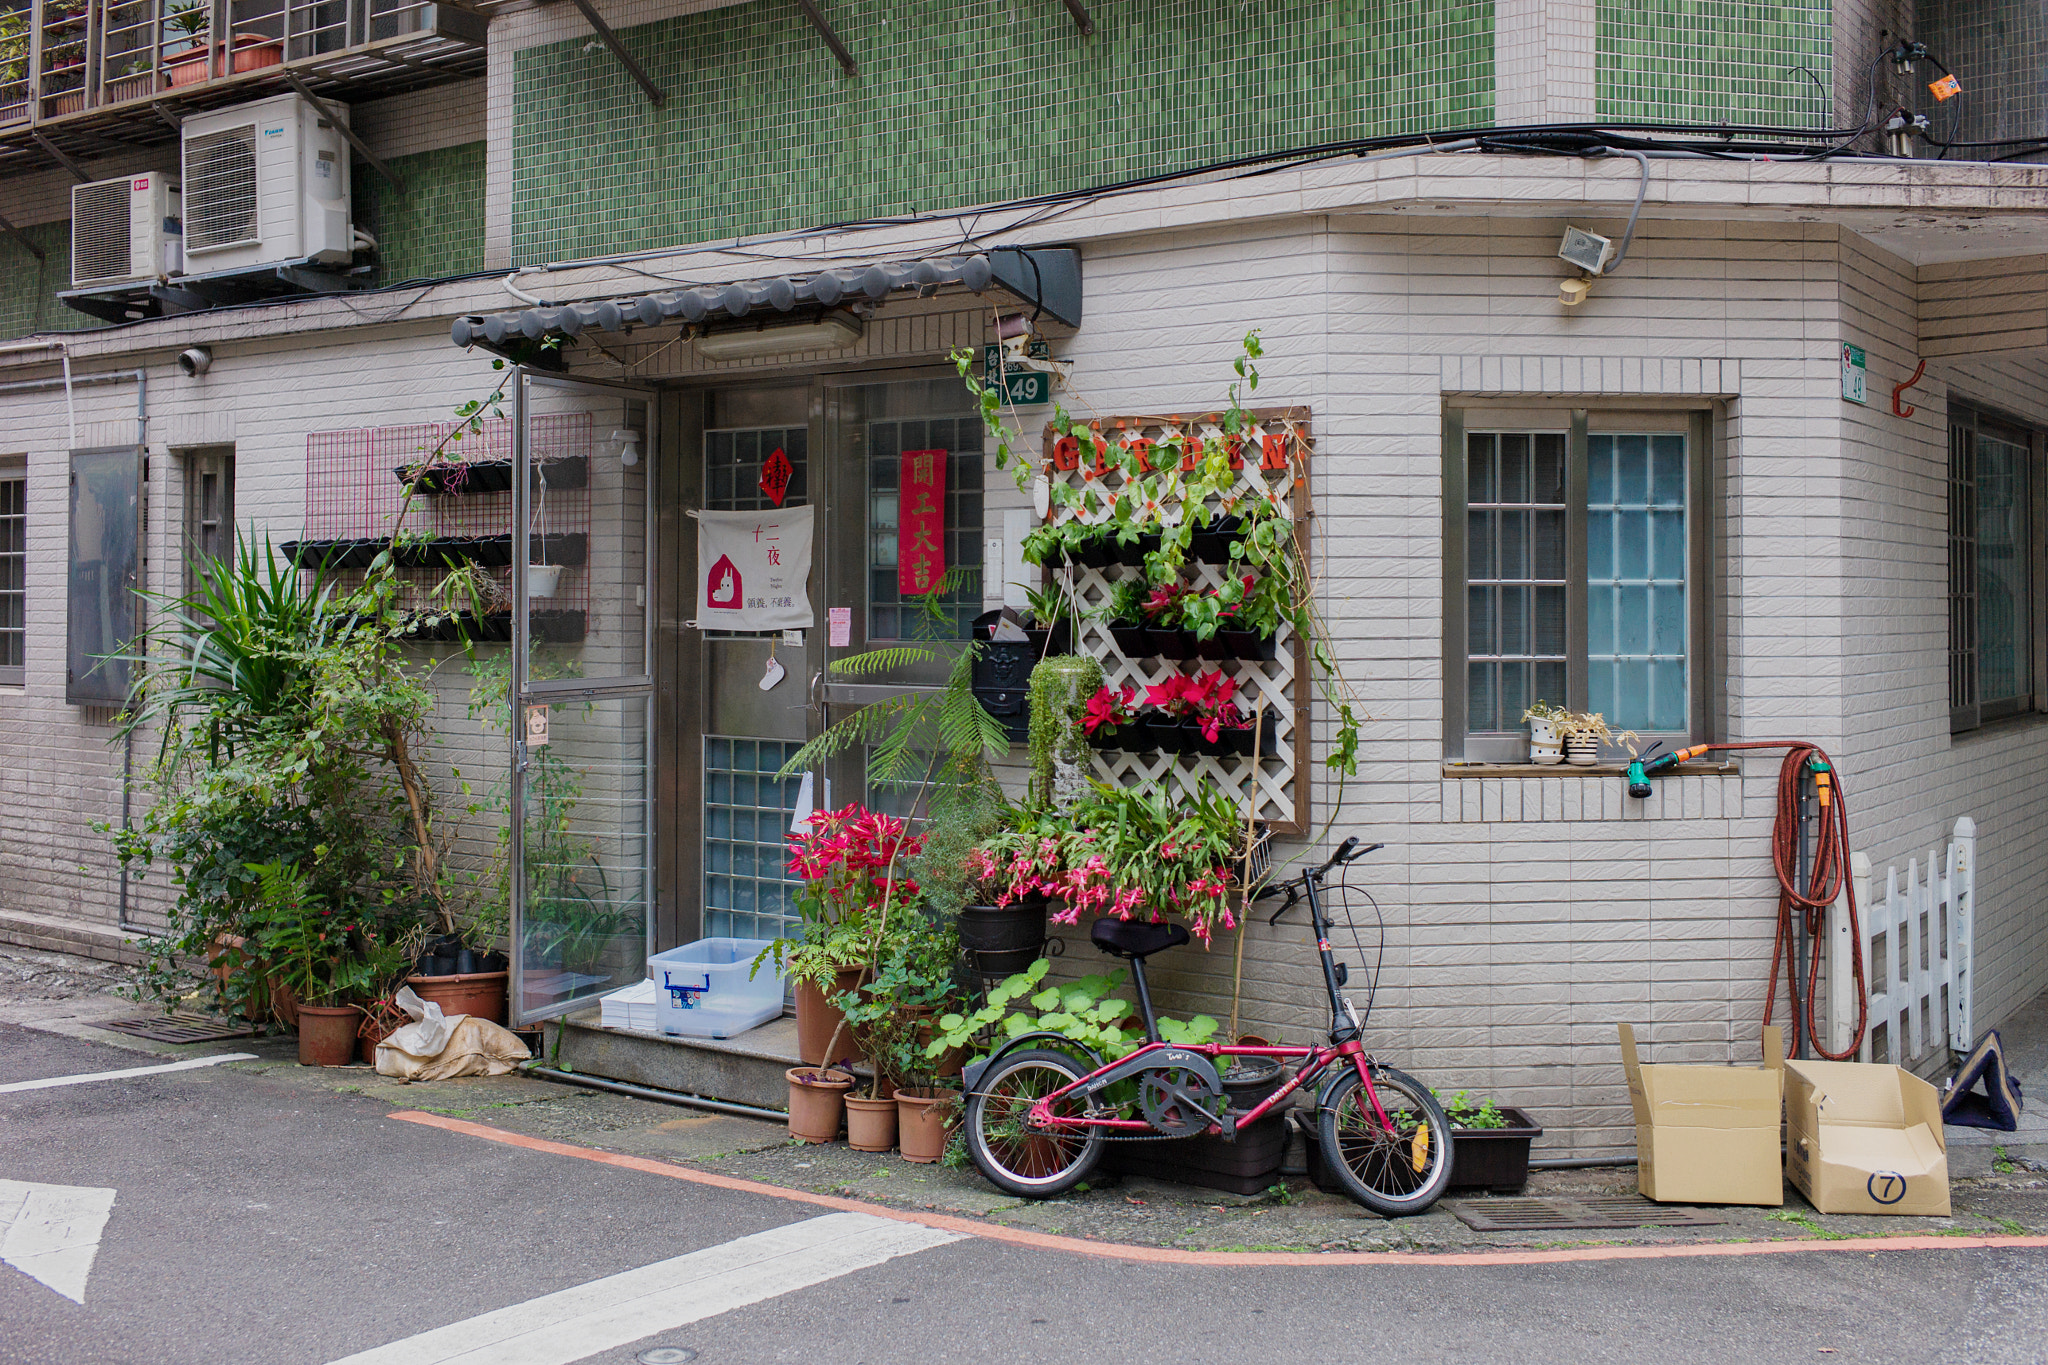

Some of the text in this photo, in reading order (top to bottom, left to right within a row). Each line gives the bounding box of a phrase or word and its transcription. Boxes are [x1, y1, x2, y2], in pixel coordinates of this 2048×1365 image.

[1010, 377, 1039, 401] 49
[911, 453, 938, 589] 開工大吉
